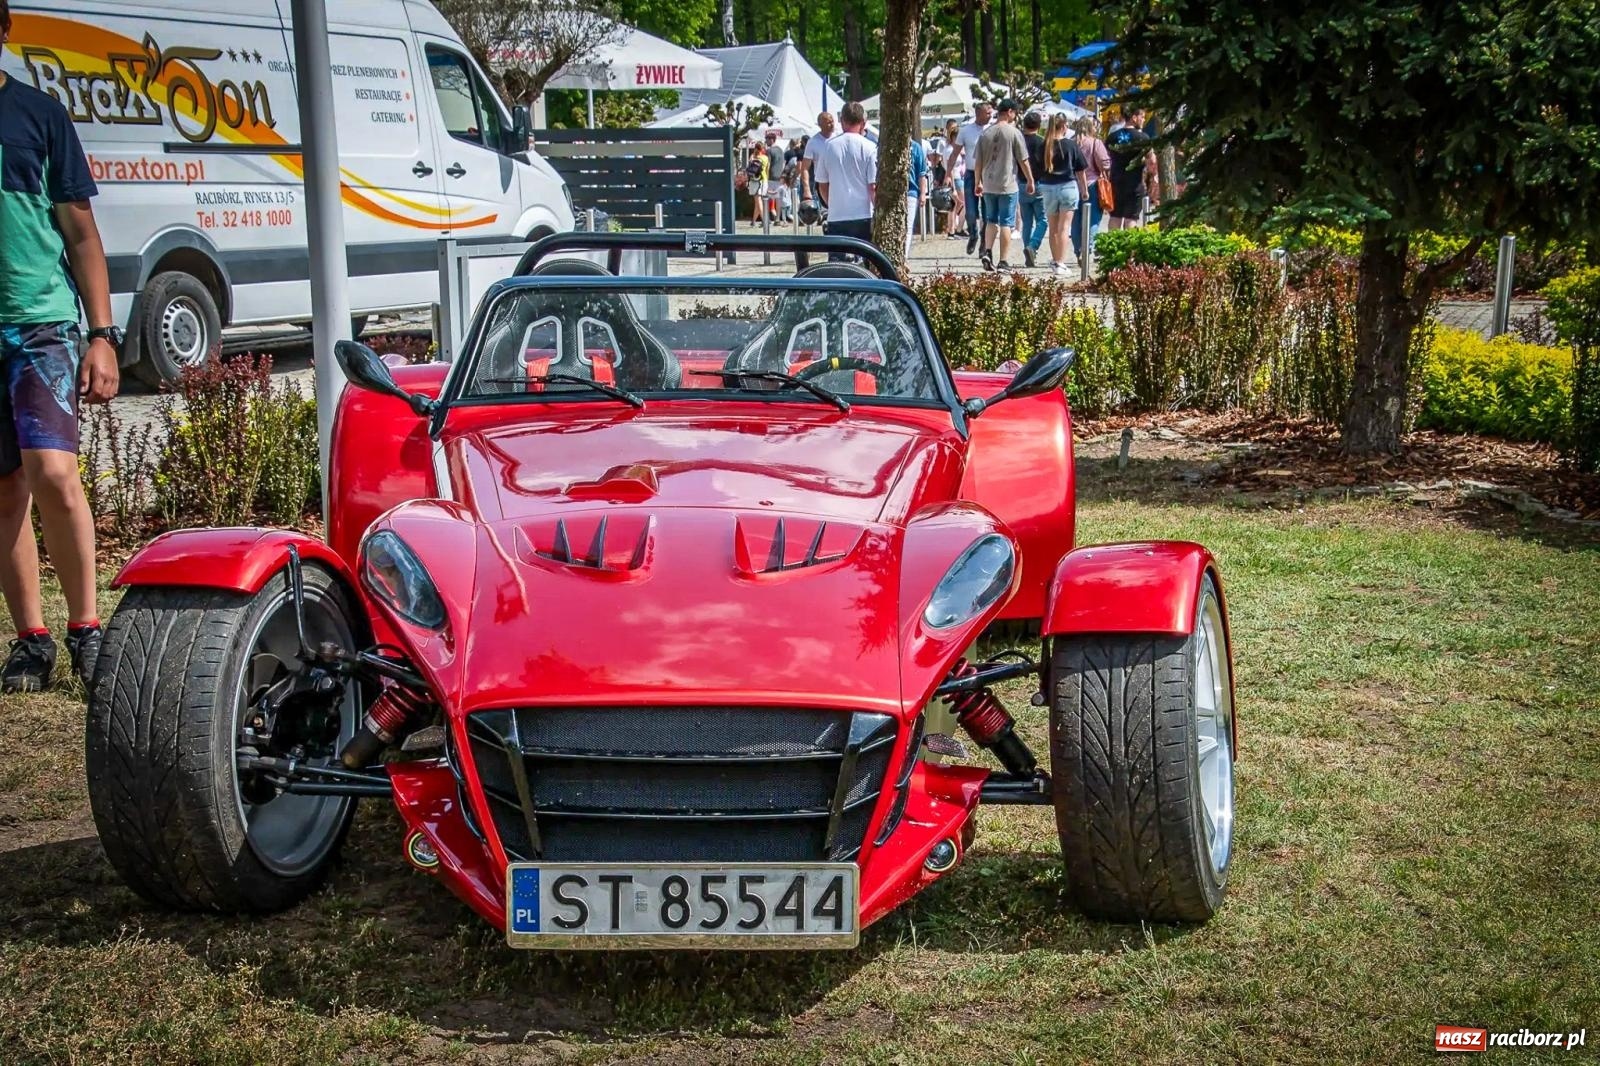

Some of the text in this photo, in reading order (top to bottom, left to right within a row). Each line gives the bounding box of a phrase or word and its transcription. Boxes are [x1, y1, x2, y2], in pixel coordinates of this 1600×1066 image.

[347, 65, 399, 79] PLENEROWYCH
[636, 63, 686, 85] ŻYWIEC
[355, 88, 402, 103] RESTAURACJE
[371, 111, 406, 124] CATERING
[88, 153, 205, 185] braxton.pl
[195, 188, 296, 206] RACIBÓRZ, RYNEK 13/5
[197, 209, 292, 229] Tel. 32 418 1000
[551, 874, 844, 930] ST 85544
[516, 909, 536, 924] PL
